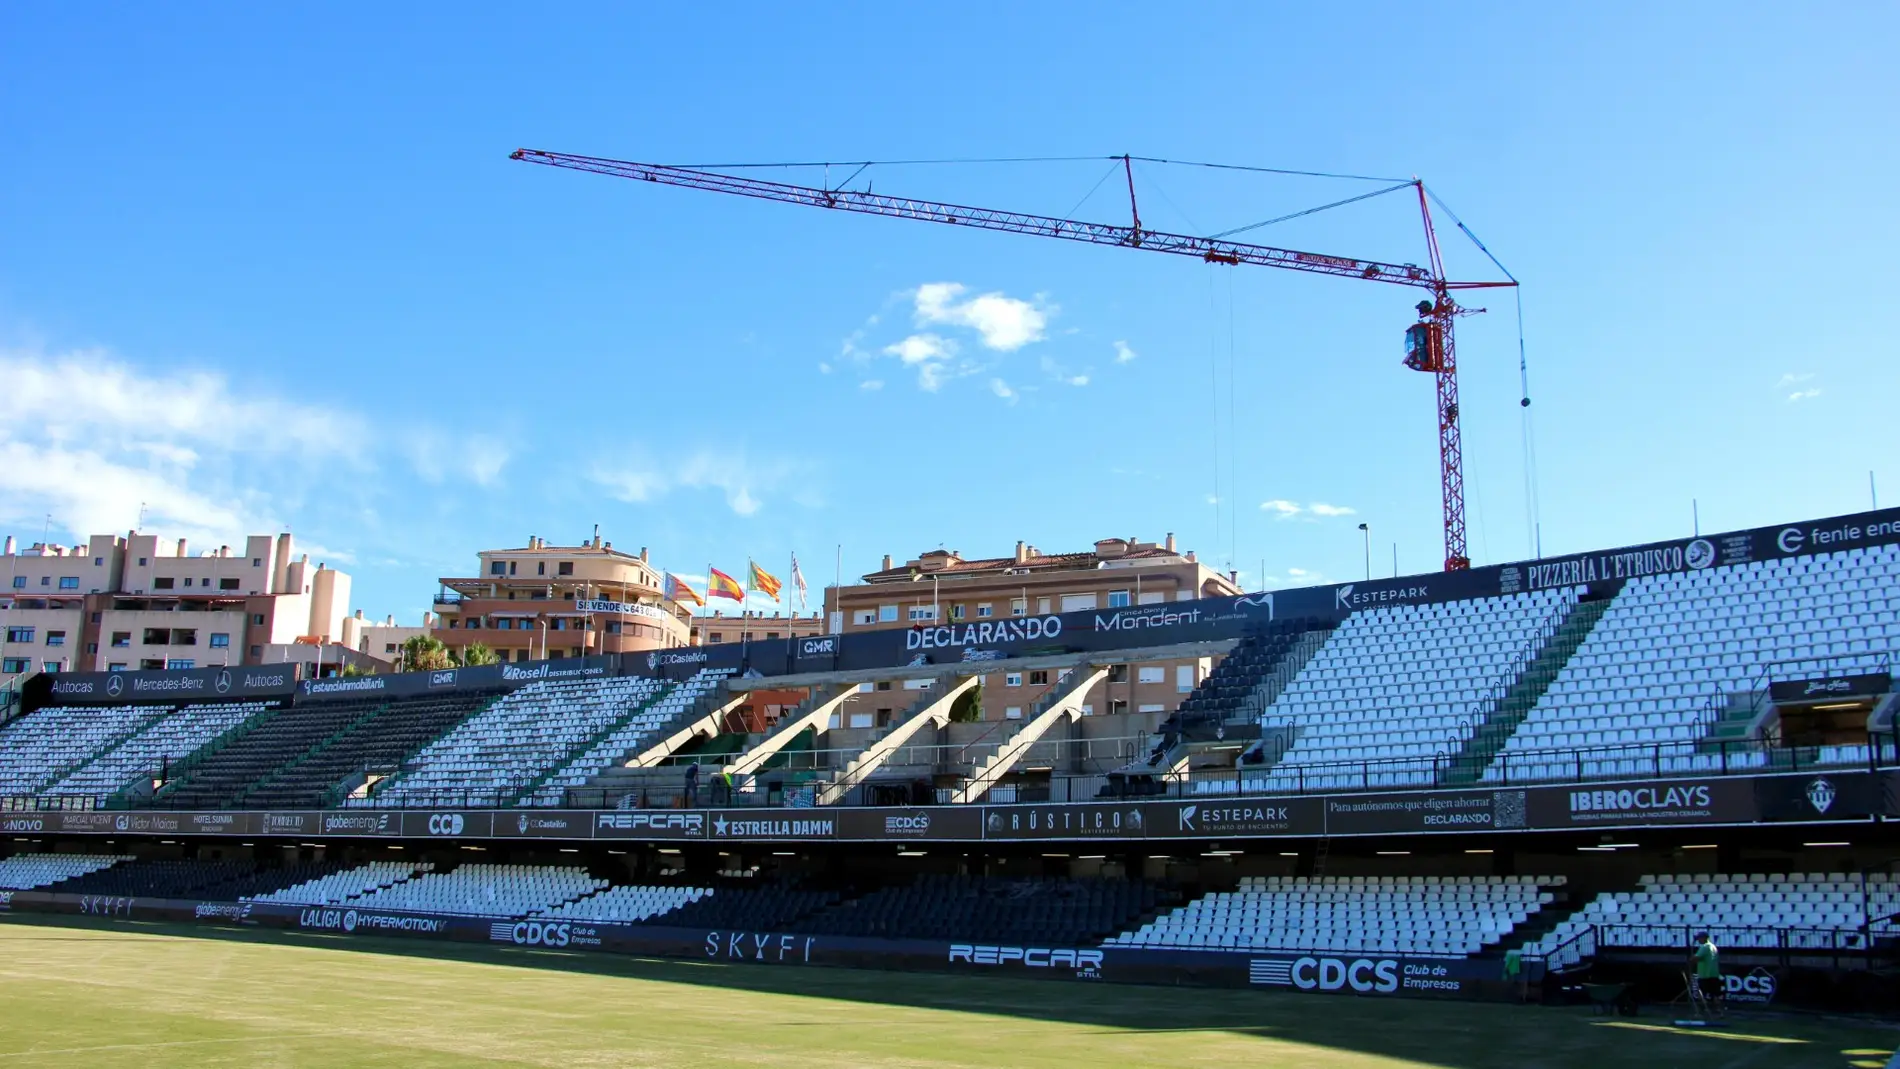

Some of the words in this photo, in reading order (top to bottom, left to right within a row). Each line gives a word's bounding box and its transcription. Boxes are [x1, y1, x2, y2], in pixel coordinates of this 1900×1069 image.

[1810, 524, 1861, 545] fenie
[1528, 556, 1597, 589] PIZZERÍA
[1601, 546, 1683, 580] L'ETRUSCO
[1353, 586, 1428, 604] ESTEPARK
[591, 601, 621, 612] VENDE
[1094, 608, 1202, 633] Mondent
[906, 615, 1062, 650] DECLARANDO
[804, 640, 833, 653] GMR
[432, 672, 453, 684] GMR
[512, 664, 549, 680] Rosell
[51, 680, 94, 694] Autocas
[133, 676, 204, 692] Mercedes-Benz
[243, 674, 284, 688] Autocas
[1330, 801, 1351, 812] Para
[1352, 799, 1403, 812] autónomos
[1405, 801, 1423, 812] que
[1423, 798, 1453, 811] eligen
[1454, 797, 1491, 809] ahorrar
[1570, 786, 1710, 812] IBEROCLAYS
[598, 813, 703, 830] REPCAR
[895, 817, 928, 829] CDCS
[1012, 809, 1120, 830] RÚSTICO
[1202, 807, 1288, 822] ESTEPARK
[1424, 813, 1491, 825] DECLARANDO
[326, 815, 378, 832] globeenergy
[428, 813, 464, 835] CCD
[732, 820, 790, 836] ESTRELLA
[792, 820, 833, 836] DAMM
[300, 908, 342, 929] LALIGA
[512, 921, 571, 947] CDCS
[949, 944, 1103, 969] REPCAR
[1291, 957, 1398, 993] CDCS
[1404, 964, 1430, 976] Club
[1432, 964, 1447, 976] de
[1403, 977, 1460, 991] Empresas
